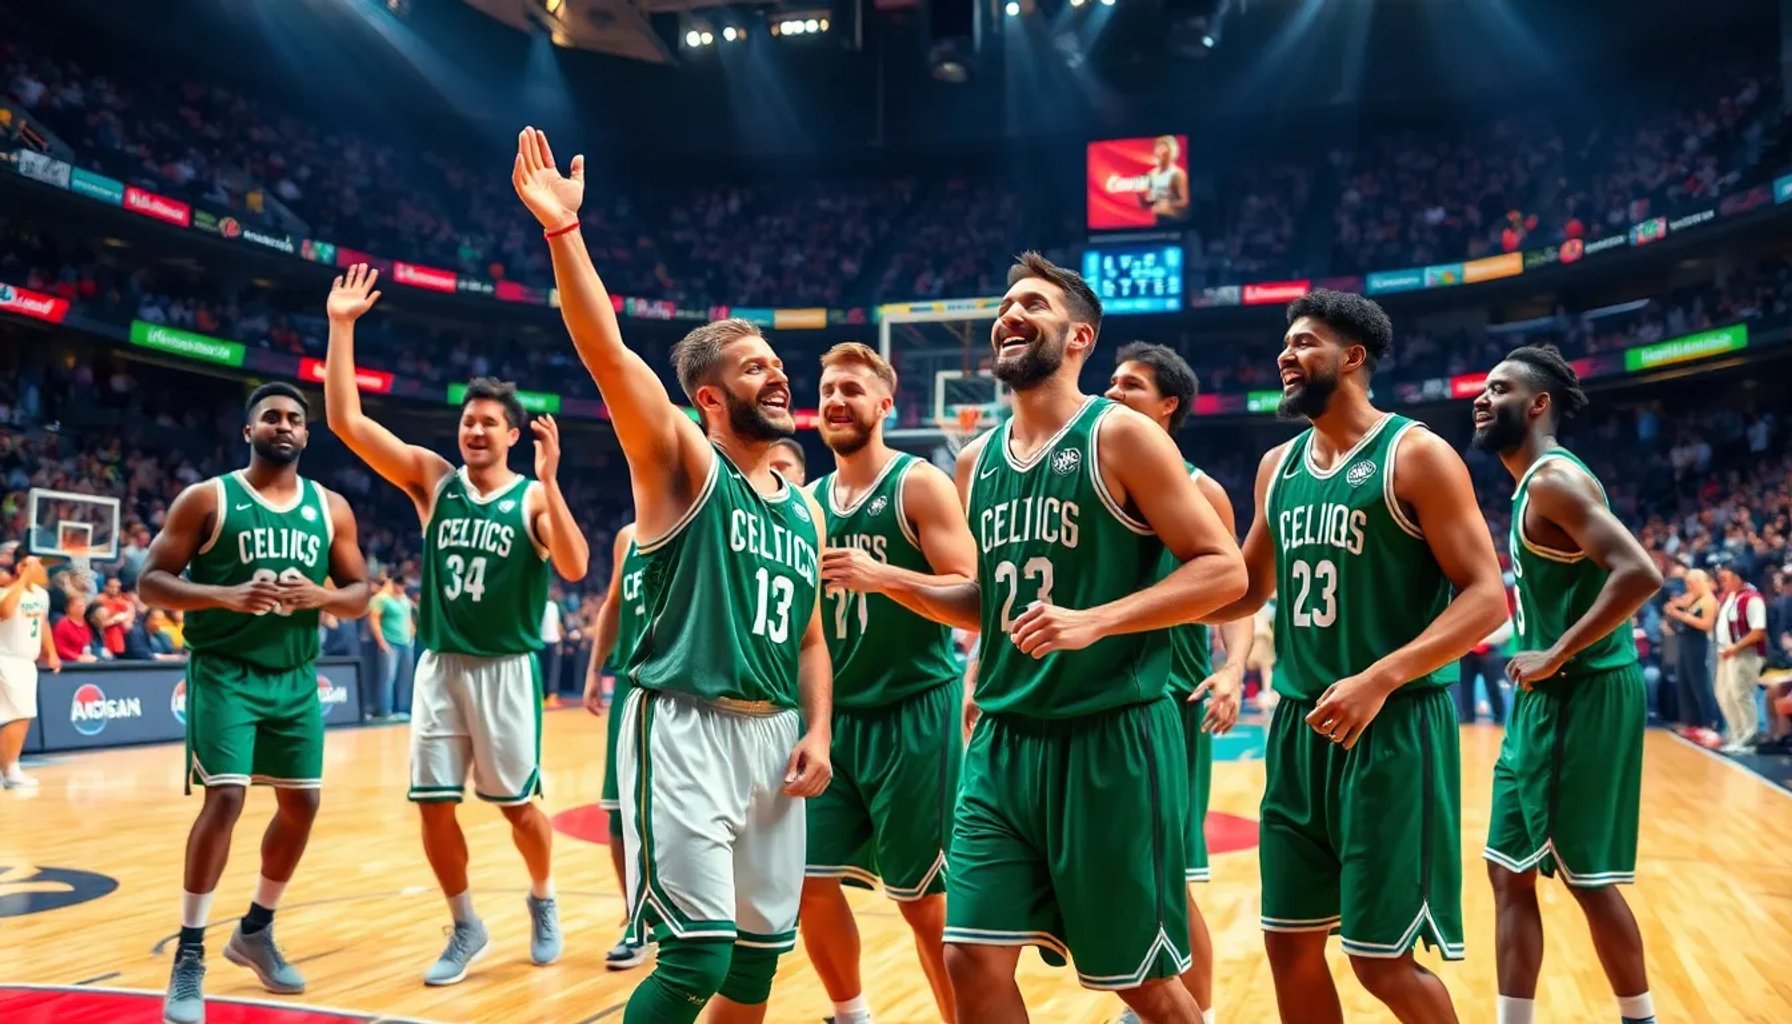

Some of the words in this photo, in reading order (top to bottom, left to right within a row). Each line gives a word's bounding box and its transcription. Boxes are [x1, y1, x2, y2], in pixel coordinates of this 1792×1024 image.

[437, 518, 515, 558] CELTICS
[980, 496, 1080, 554] CELTICS
[444, 554, 487, 602] 34
[752, 566, 795, 644] 13
[1292, 559, 1338, 628] 23
